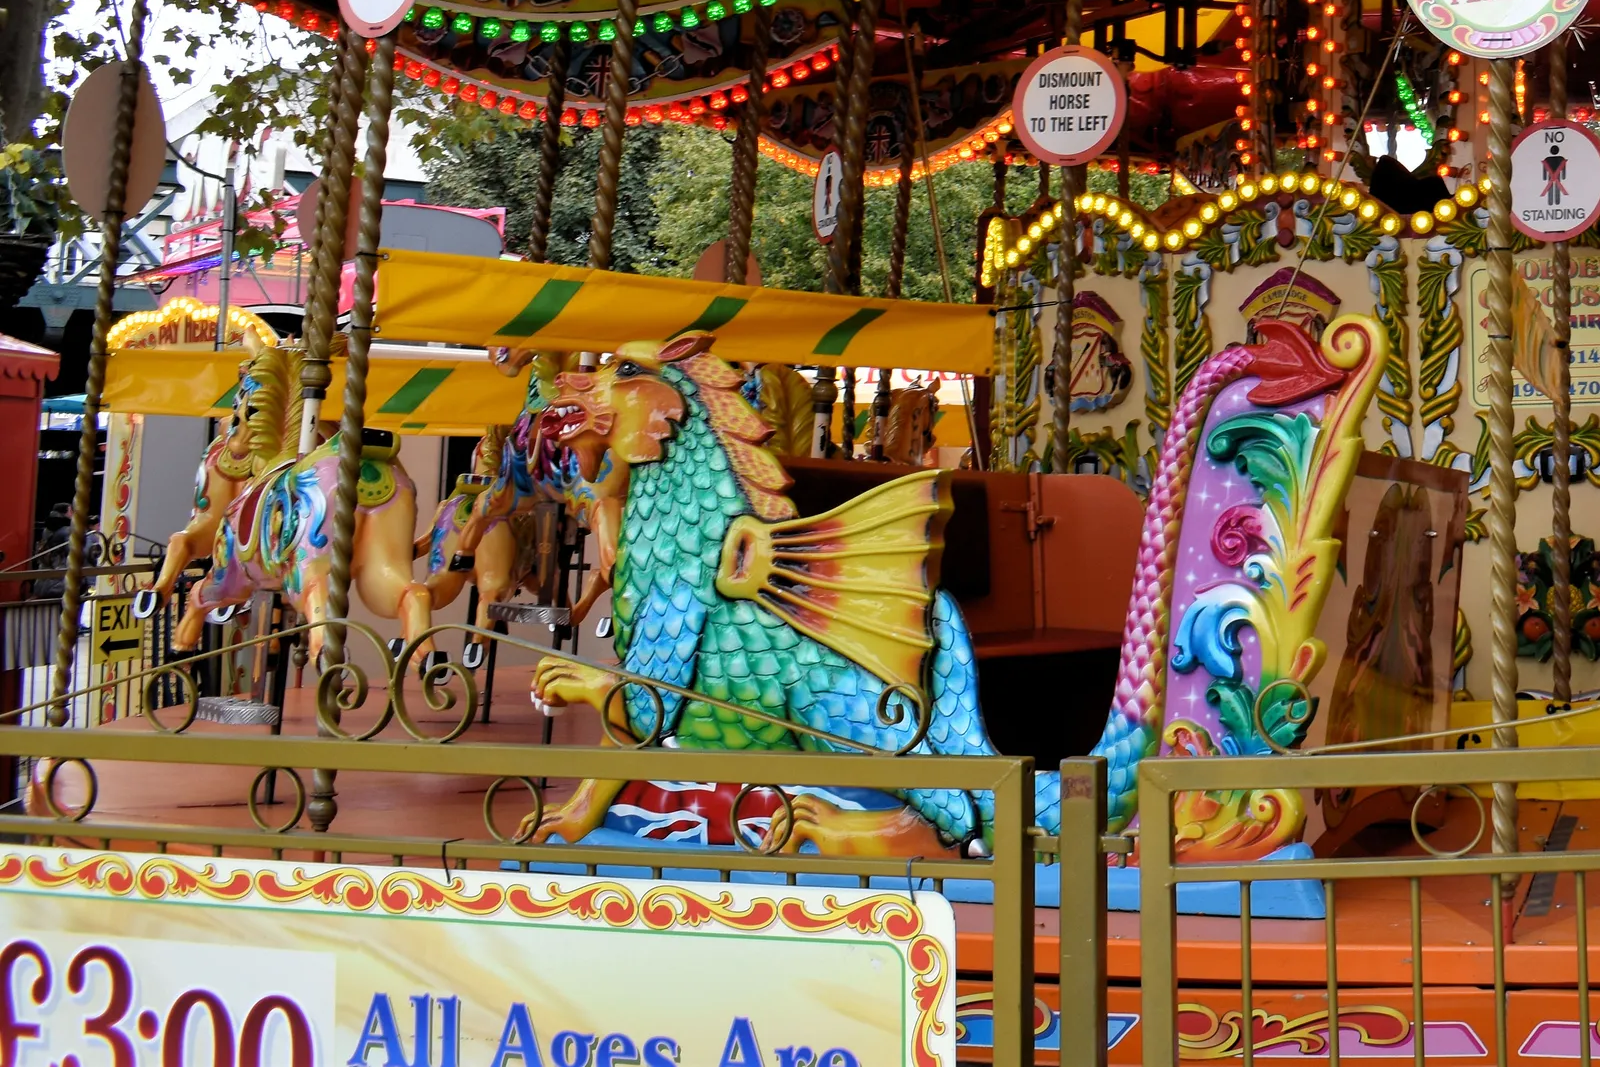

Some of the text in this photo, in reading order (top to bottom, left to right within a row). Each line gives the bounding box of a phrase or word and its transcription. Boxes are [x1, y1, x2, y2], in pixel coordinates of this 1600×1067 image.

[1039, 71, 1103, 88] DISMOUNT
[1049, 94, 1090, 110] HORSE
[1030, 115, 1108, 132] TO THE LEFT
[1544, 131, 1565, 144] NO
[1522, 208, 1586, 222] STANDING
[158, 315, 218, 346] PAY HERE
[346, 991, 862, 1067] All Ages Are
